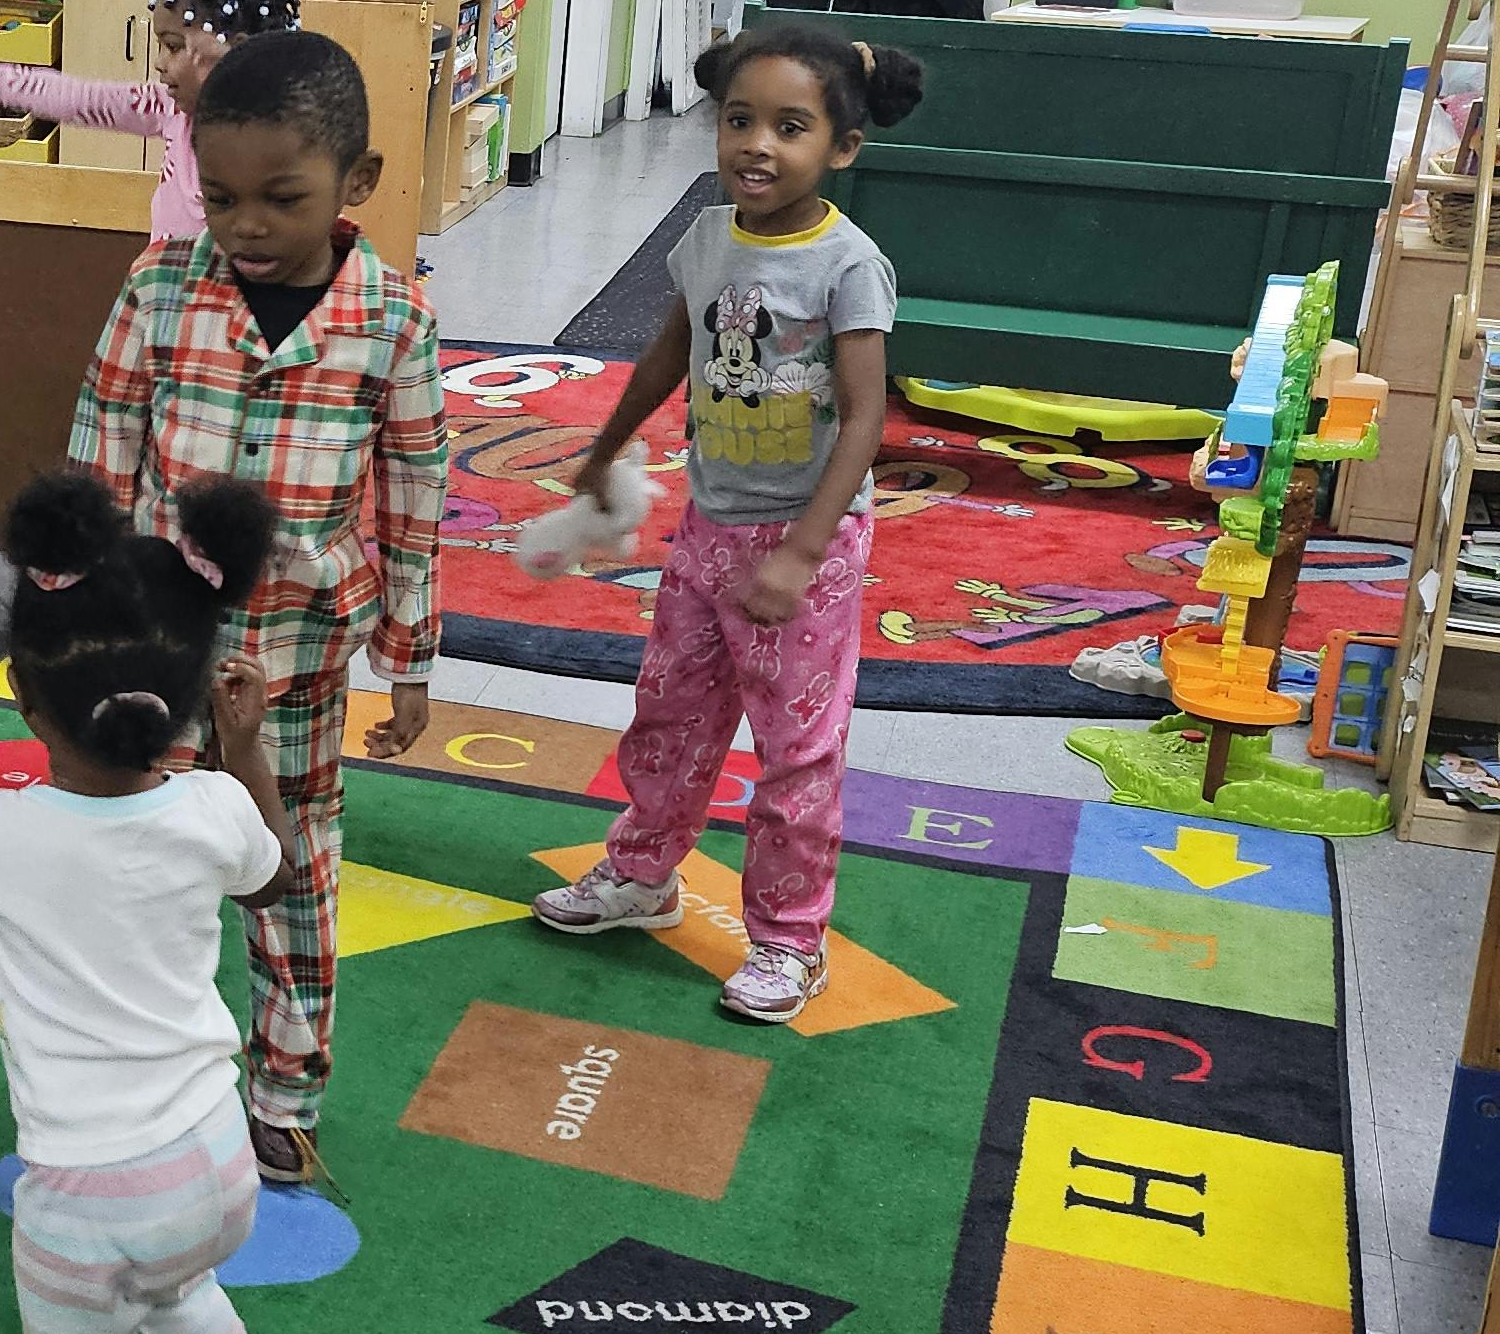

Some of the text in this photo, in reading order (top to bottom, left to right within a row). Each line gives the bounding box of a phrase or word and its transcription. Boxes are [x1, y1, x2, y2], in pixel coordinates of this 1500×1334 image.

[445, 733, 534, 769] C
[900, 805, 995, 850] E
[1100, 915, 1218, 969] F
[1081, 1025, 1213, 1082] G
[547, 1043, 619, 1142] square
[1064, 1146, 1208, 1237] H
[535, 1296, 812, 1333] diamond
